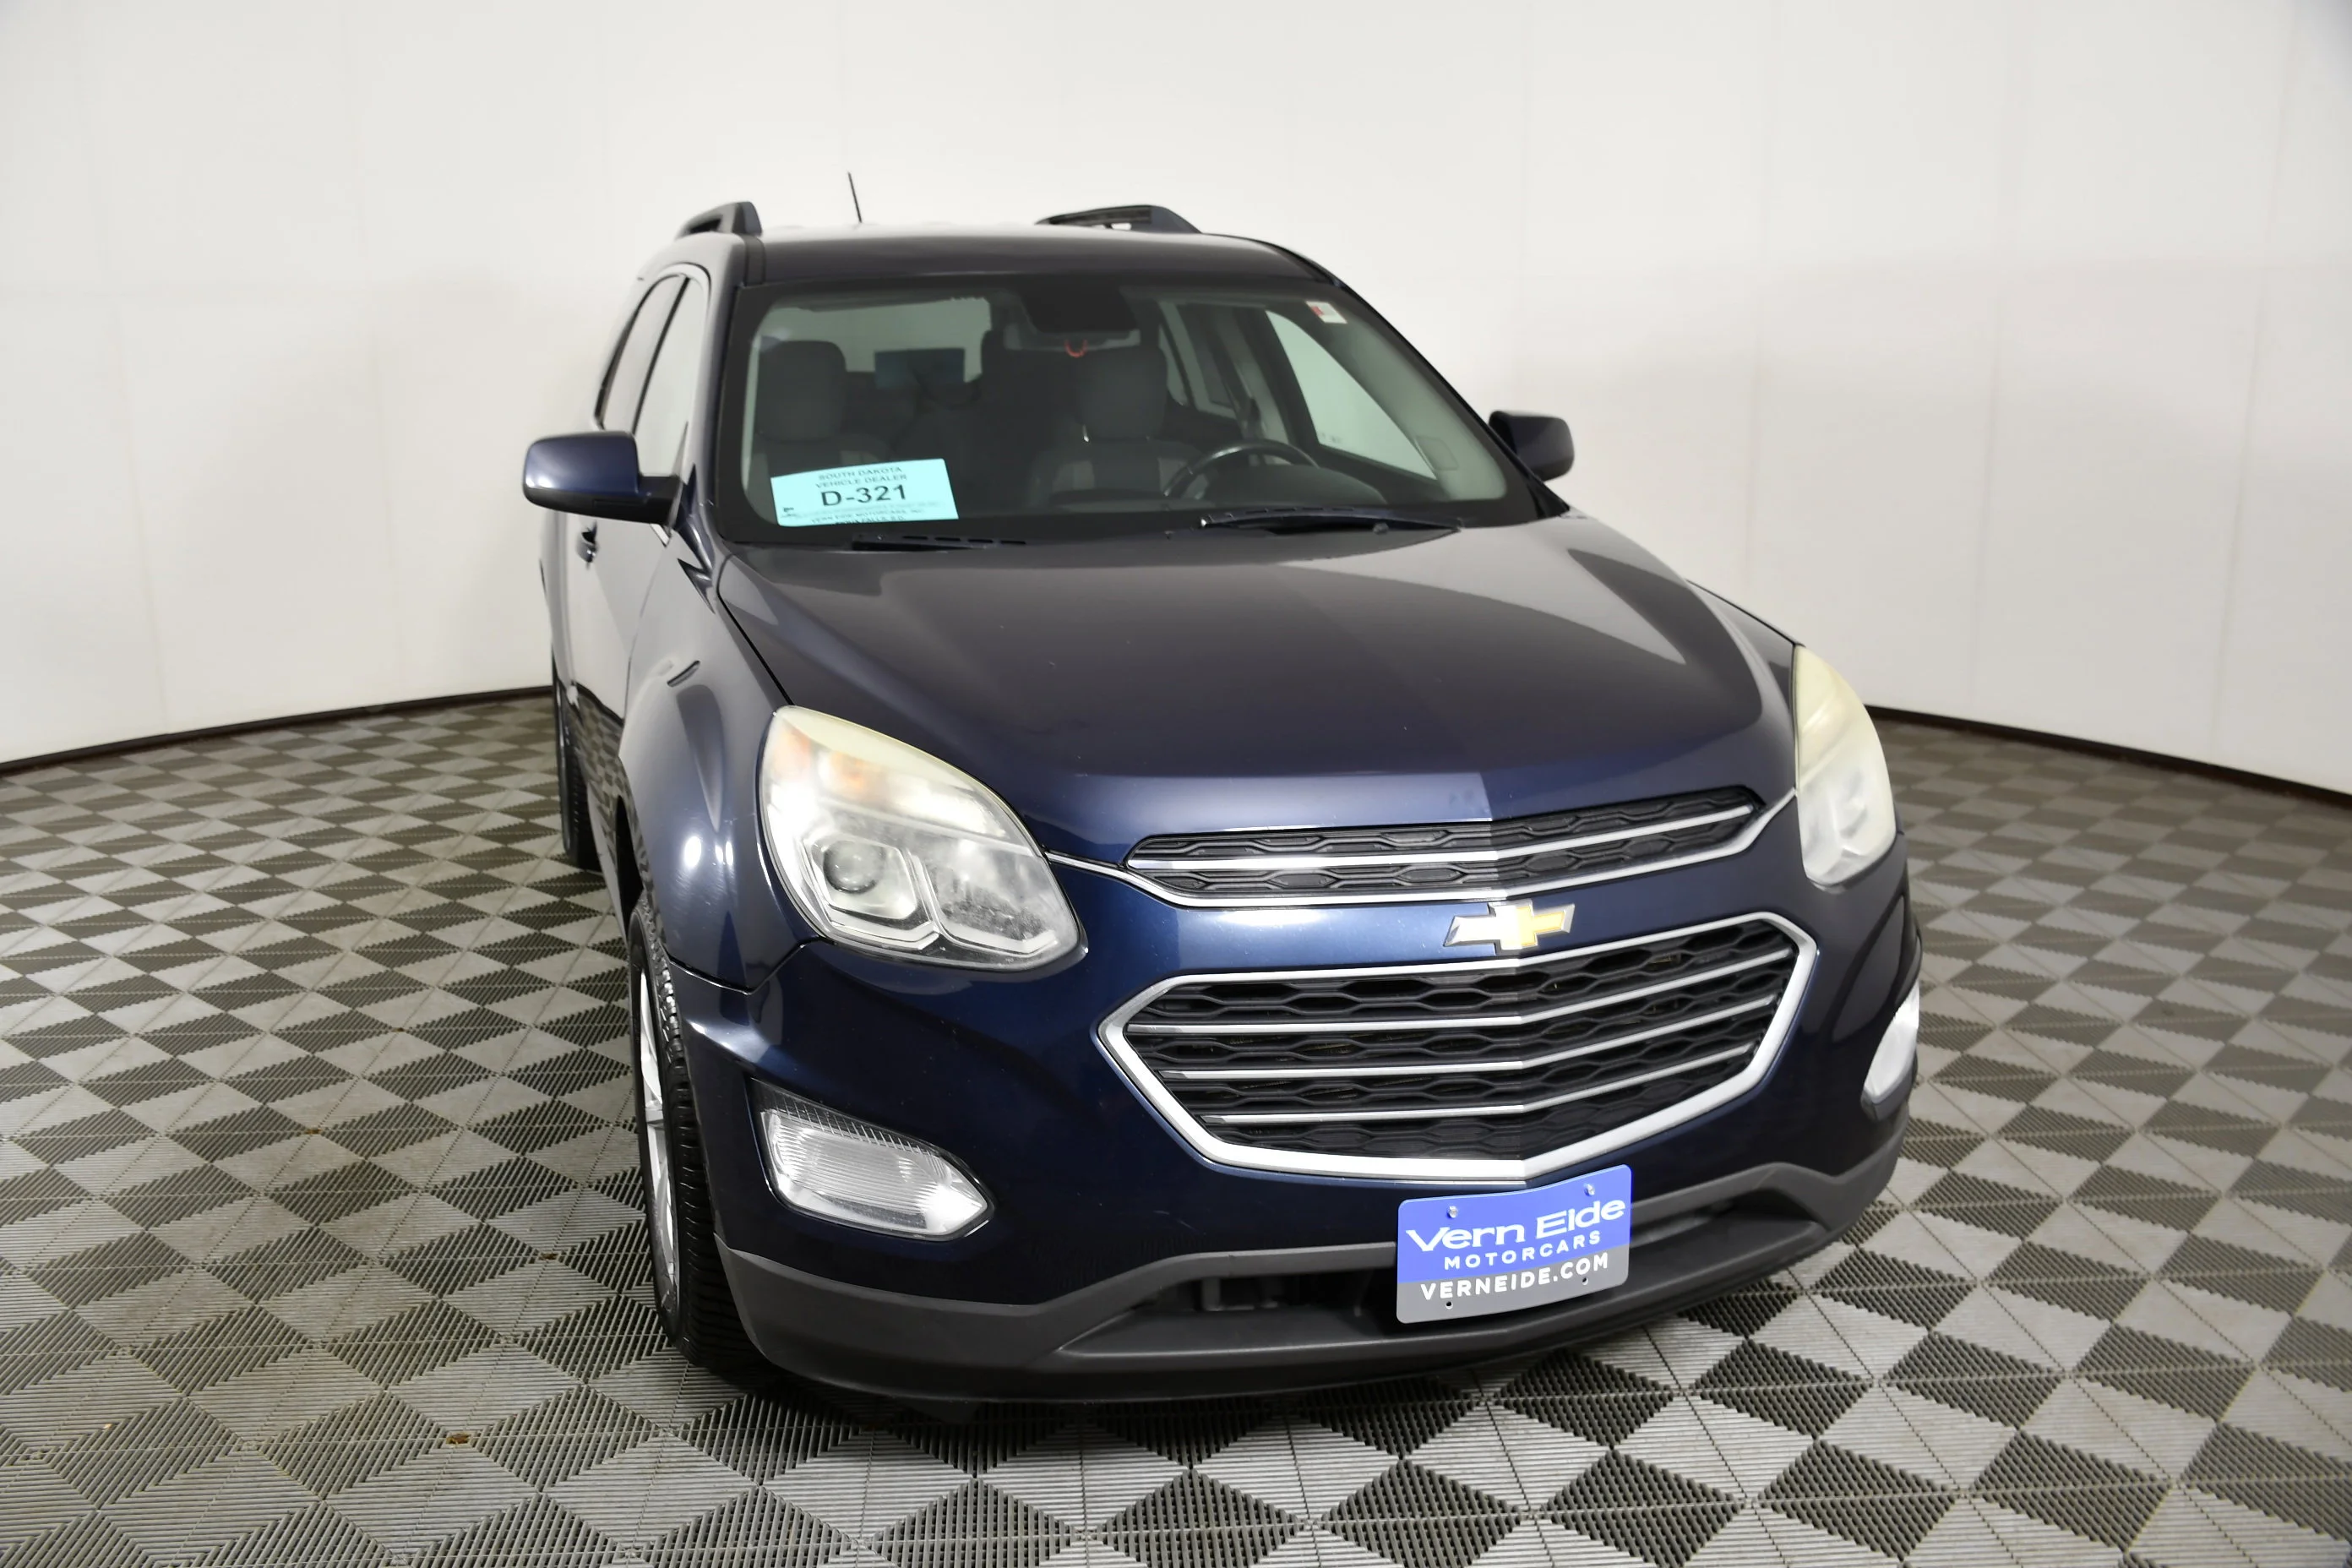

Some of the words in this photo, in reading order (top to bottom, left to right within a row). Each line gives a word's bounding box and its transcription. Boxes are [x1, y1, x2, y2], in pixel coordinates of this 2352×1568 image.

[821, 484, 906, 506] D-321
[1405, 1223, 1526, 1252] Vern
[1444, 1230, 1601, 1271] MOTORCARS
[1420, 1252, 1609, 1300] VERNEIDE.COM
